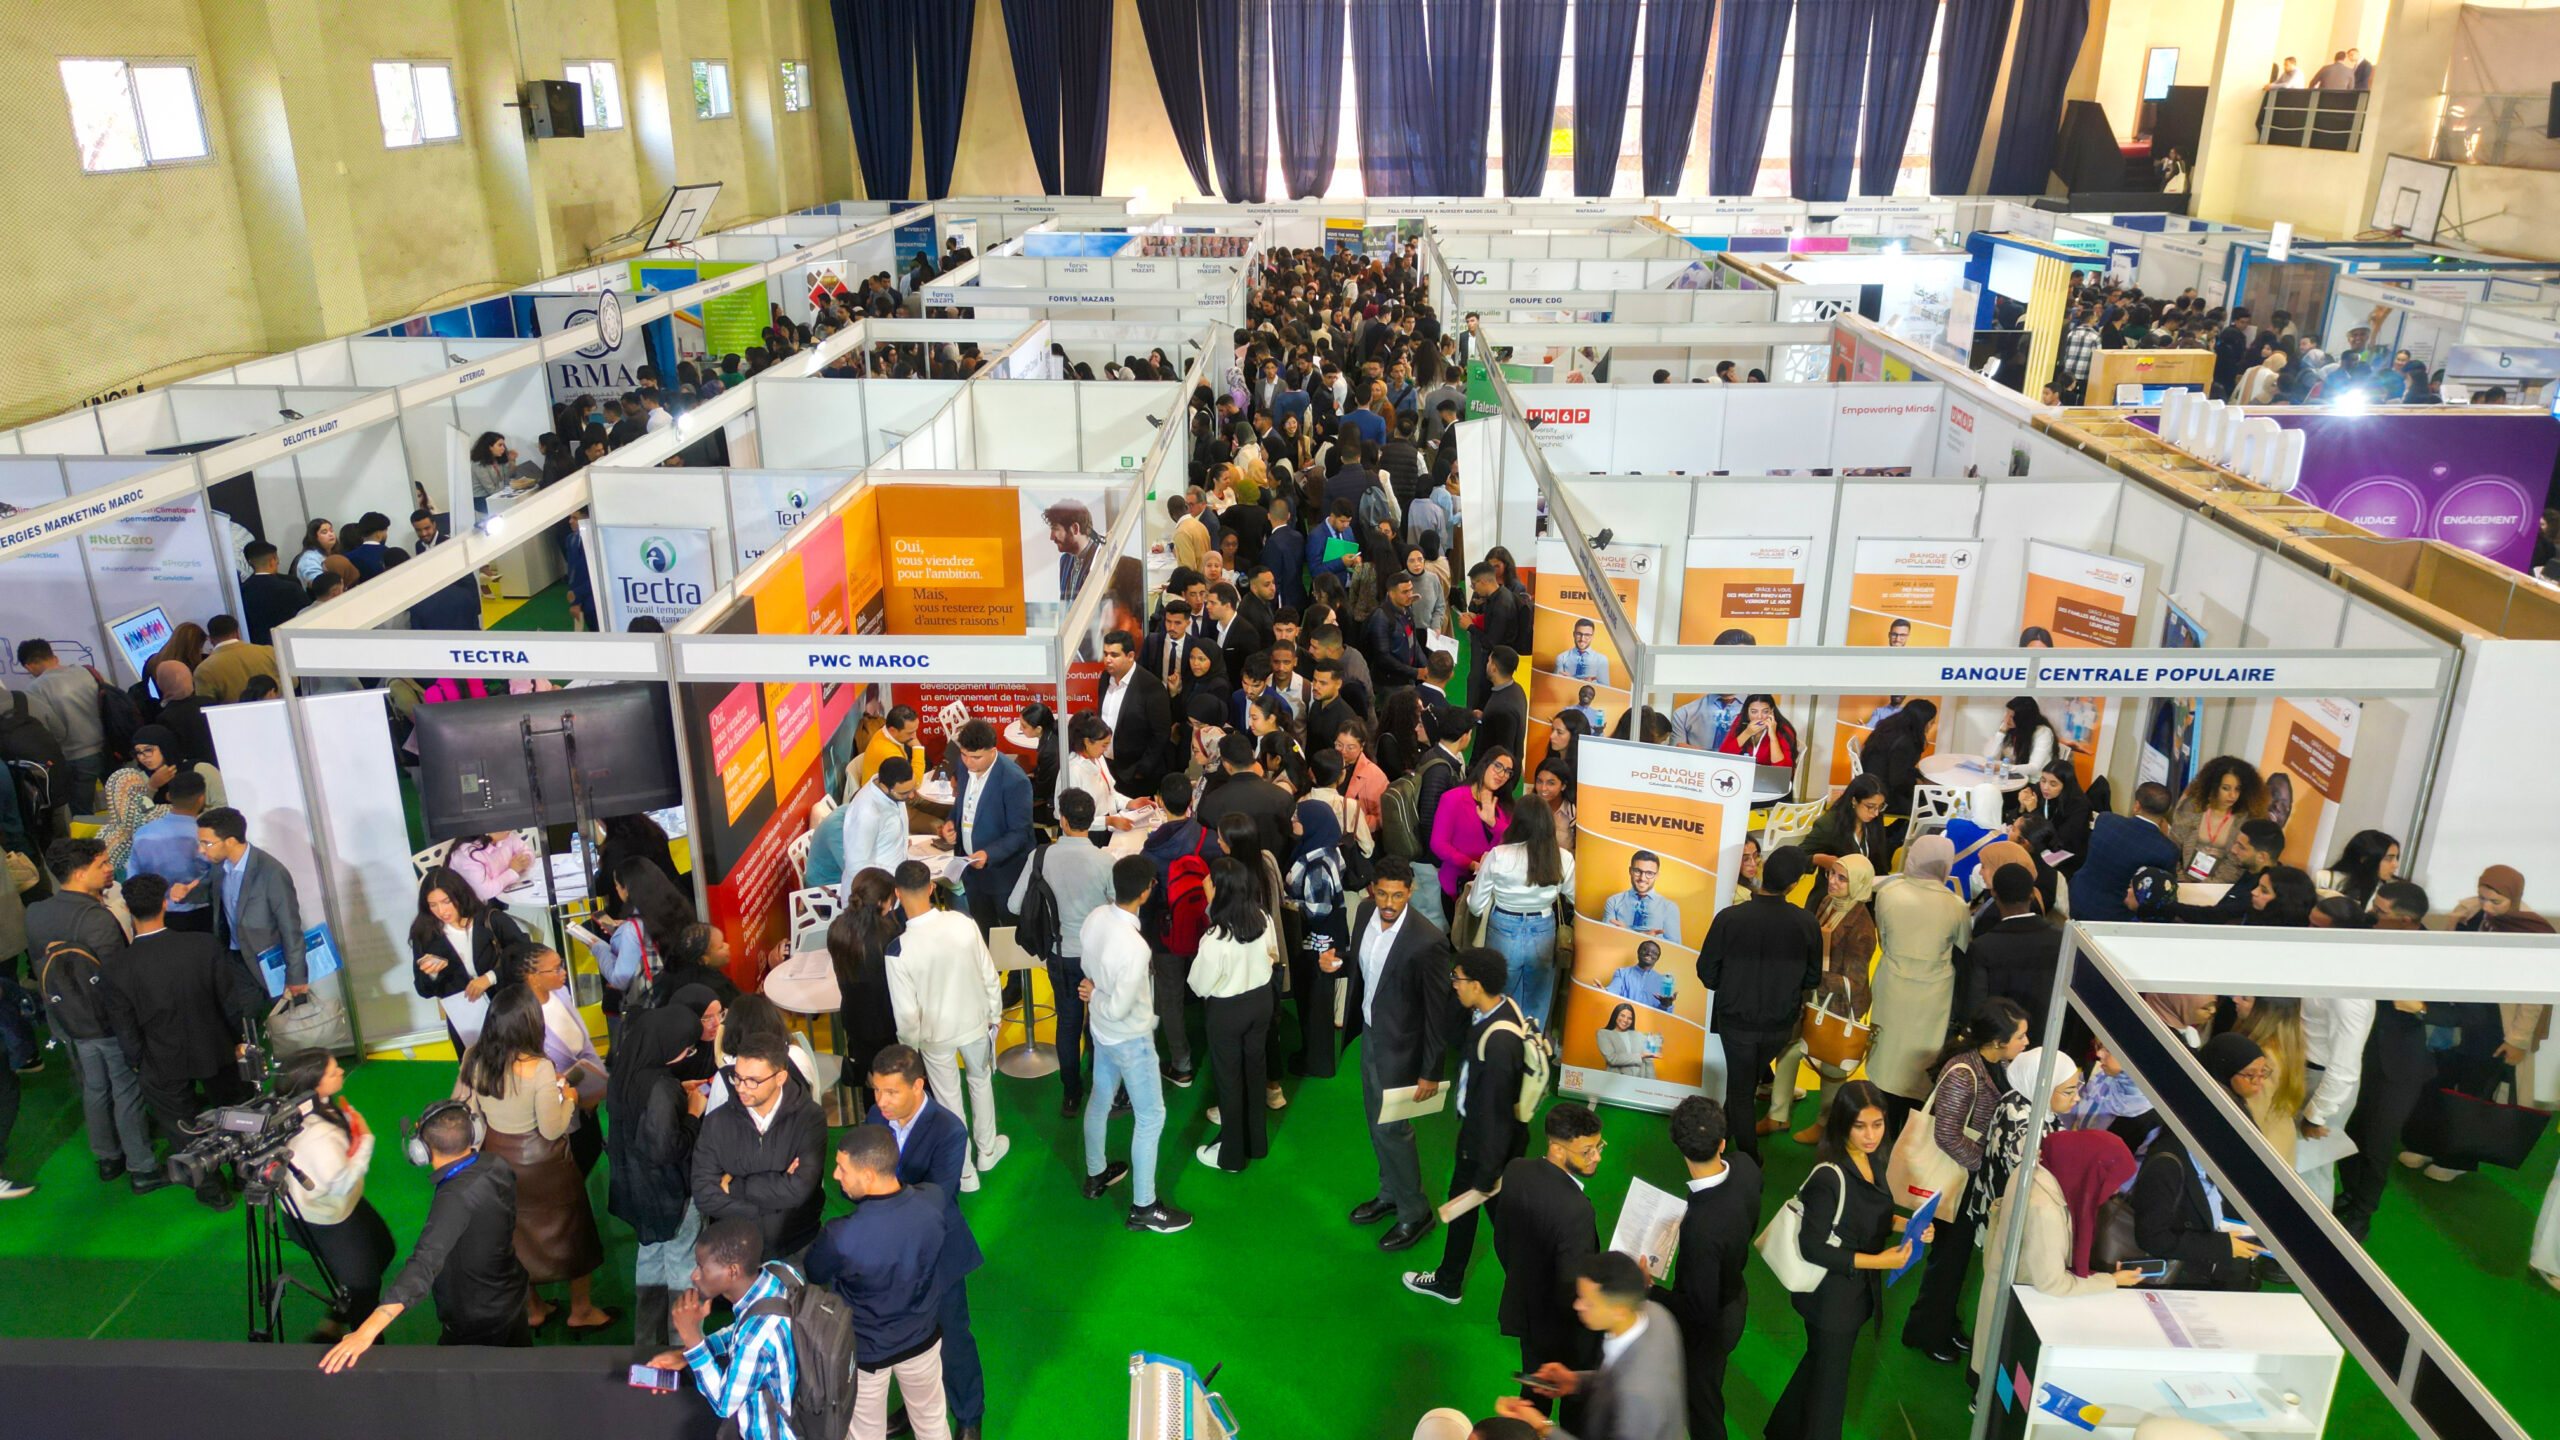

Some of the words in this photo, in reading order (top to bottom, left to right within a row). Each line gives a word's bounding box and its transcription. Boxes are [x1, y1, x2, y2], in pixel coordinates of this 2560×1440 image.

[559, 364, 639, 388] RMA
[1529, 411, 1587, 422] UM6P
[1842, 405, 1903, 416] Empowering
[1905, 404, 1937, 413] Minds.
[282, 428, 317, 447] DELOITTE
[318, 419, 339, 436] AUDIT
[0, 525, 42, 549] ERGIES
[44, 502, 107, 533] MARKETING
[108, 489, 145, 510] MAROC
[2352, 515, 2397, 525] AUDACE
[2442, 514, 2519, 526] ENGAGEMENT
[89, 534, 153, 545] #NetZero
[894, 540, 924, 555] Oui,
[896, 556, 923, 566] vous
[925, 555, 975, 567] viendrez
[897, 570, 924, 581] pour
[926, 568, 983, 580] l'ambition.
[618, 577, 702, 605] Tectra
[913, 588, 948, 602] Mais,
[1560, 590, 1627, 603] BIENE
[626, 605, 654, 614] Travail
[914, 603, 940, 613] vous
[941, 603, 984, 613] resterez
[988, 604, 1014, 617] pour
[914, 615, 958, 626] d'autres
[960, 615, 999, 626] raisons
[449, 650, 530, 664] TECTRA
[808, 654, 852, 667] PWC
[859, 654, 931, 668] MAROC
[1941, 667, 2027, 681] BANQUE
[2039, 667, 2148, 682] CENTRALE
[2155, 668, 2276, 682] POPULAIRE
[934, 693, 998, 701] environnement
[1000, 693, 1012, 701] de
[922, 704, 938, 712] des
[973, 704, 985, 712] de
[986, 704, 1013, 712] travail
[999, 715, 1011, 723] les
[1631, 770, 1705, 787] POPULAIRE
[1651, 765, 1705, 780] BANQUE
[1610, 810, 1705, 835] BIENVENUE
